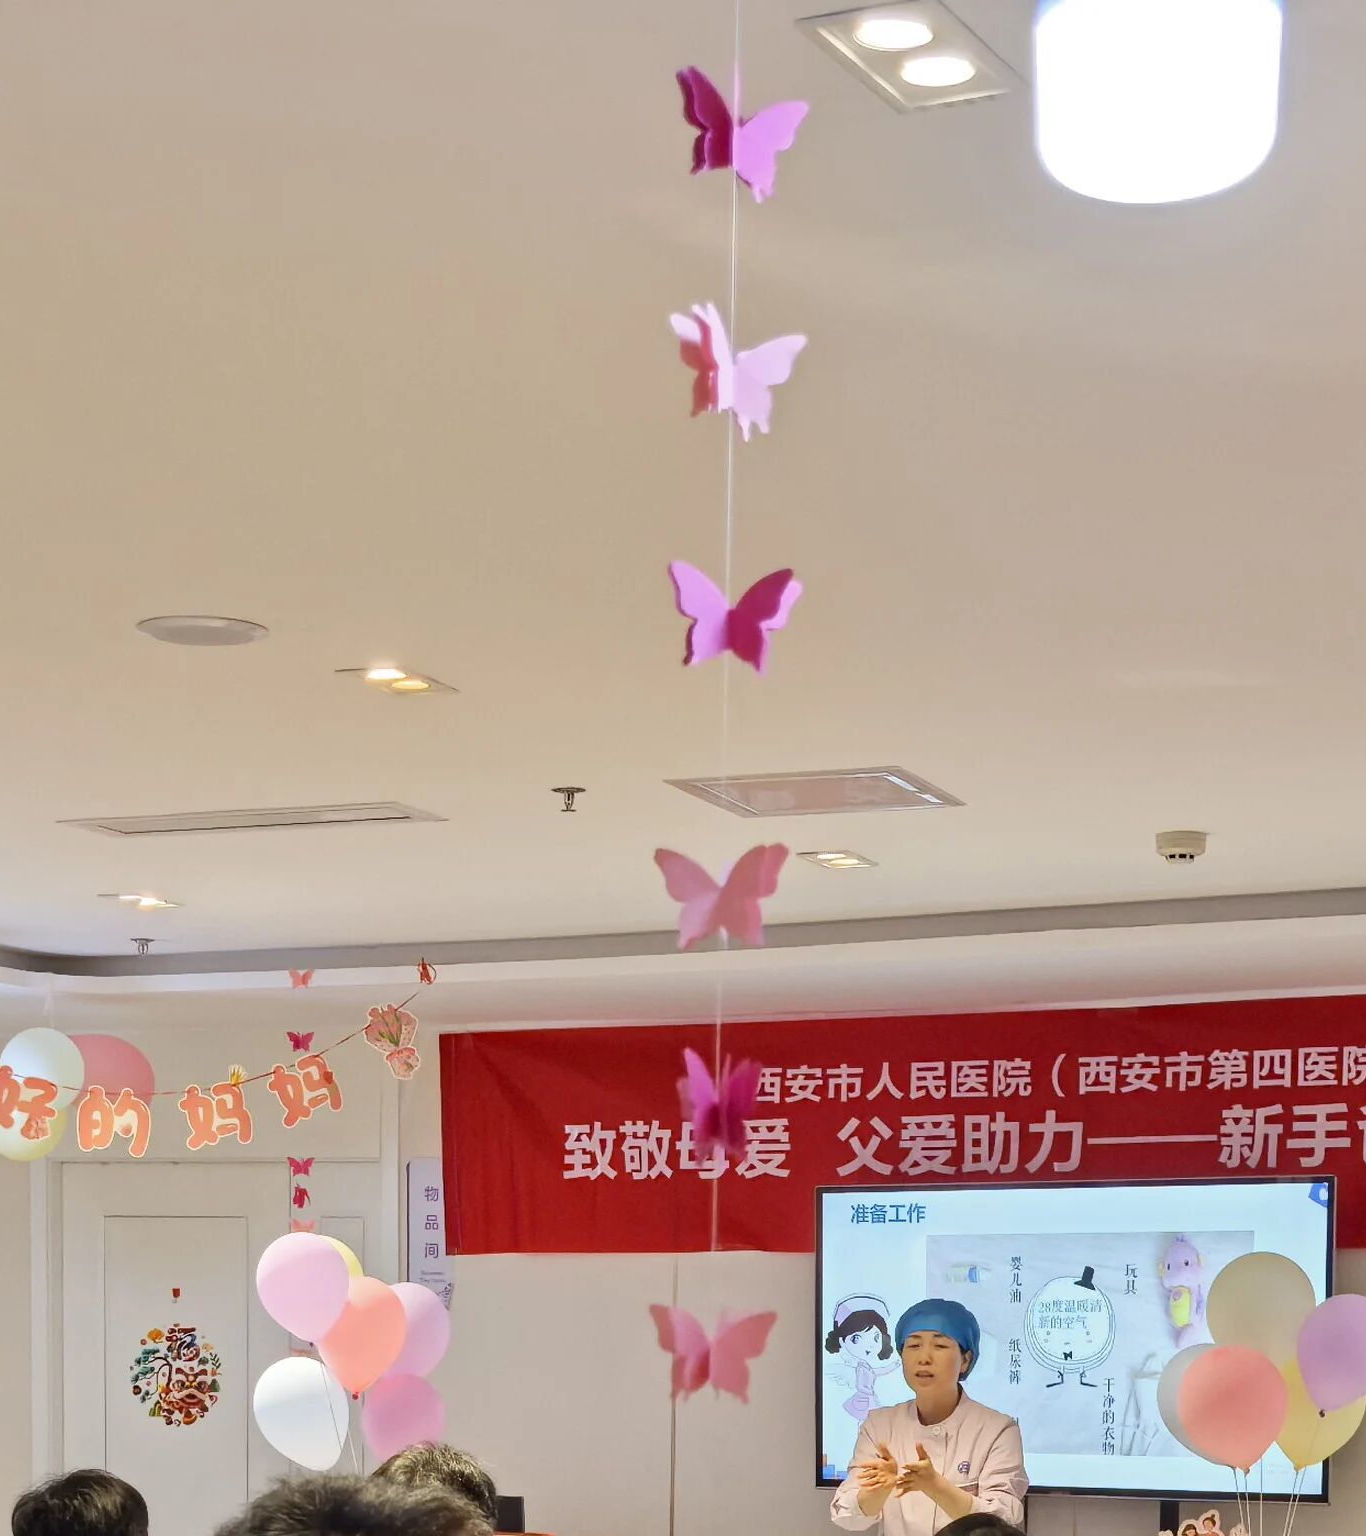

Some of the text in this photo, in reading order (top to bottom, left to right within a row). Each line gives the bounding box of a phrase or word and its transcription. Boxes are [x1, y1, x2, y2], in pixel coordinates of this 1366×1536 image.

[424, 1185, 439, 1259] 物品间
[849, 1203, 927, 1225] 准备工作
[1009, 1255, 1023, 1304] 婴儿油
[1124, 1263, 1138, 1295] 玩具
[1038, 1298, 1103, 1314] 28度温暖清
[1038, 1314, 1088, 1330] 新的空气
[1008, 1337, 1023, 1385] 纸尿裤
[1101, 1376, 1116, 1457] 干净的衣物
